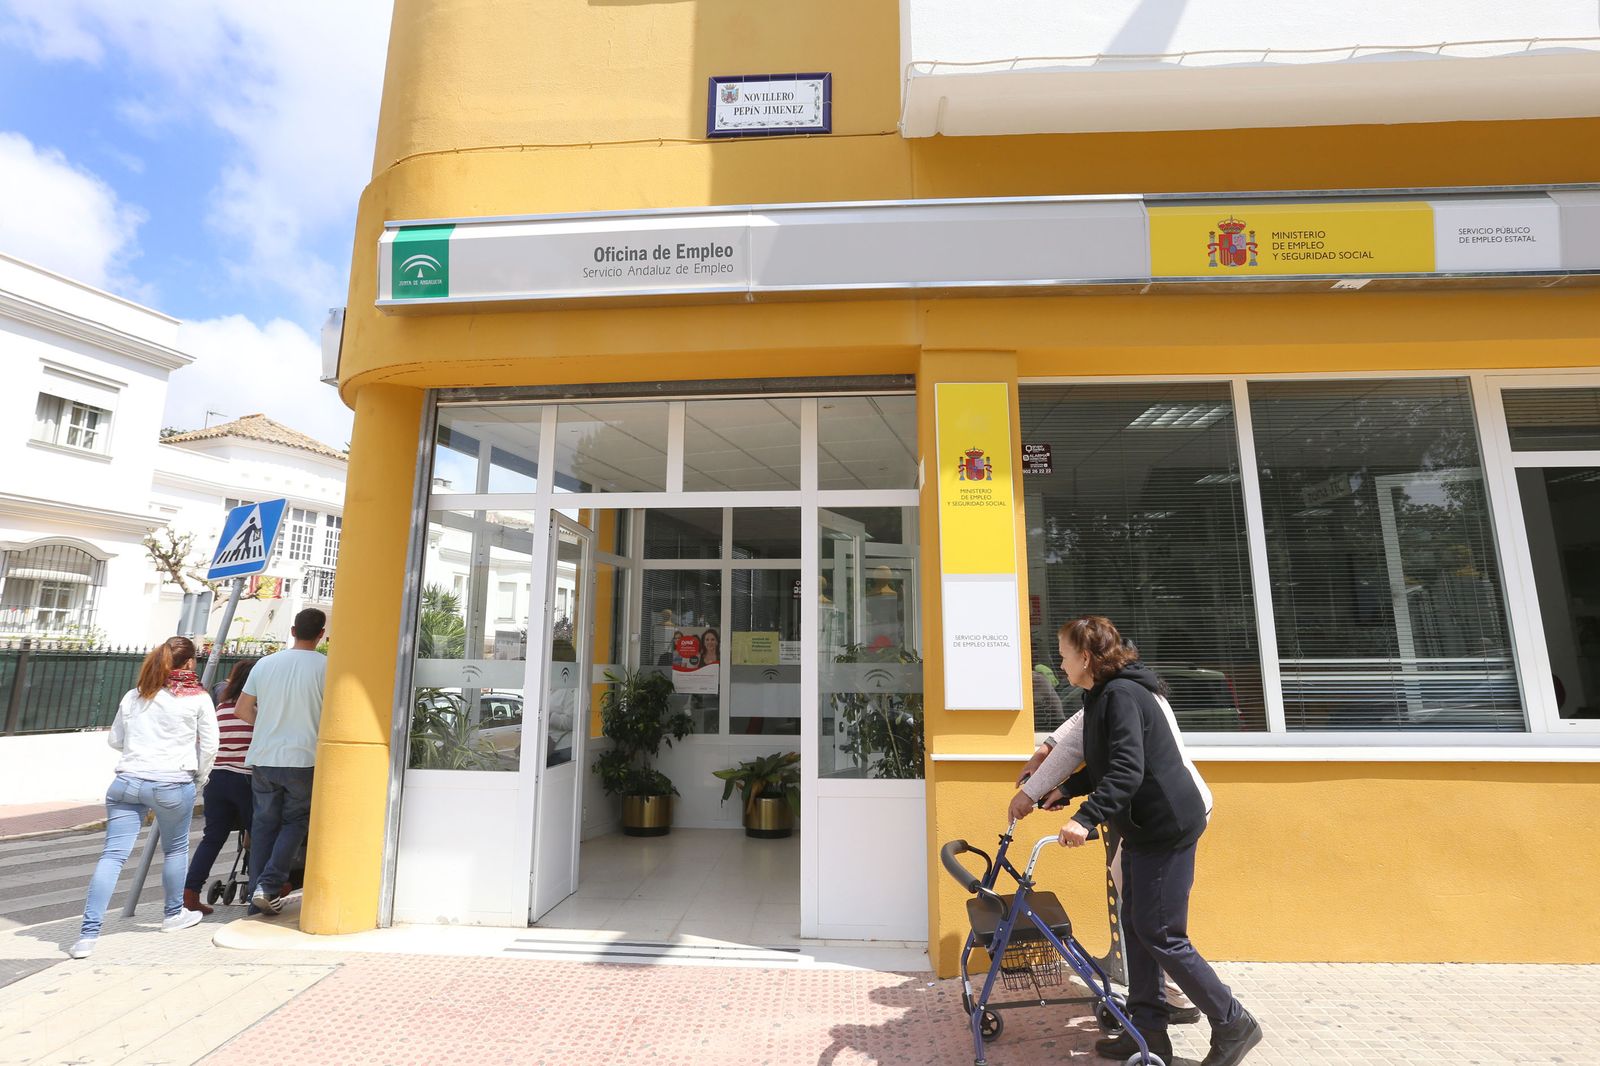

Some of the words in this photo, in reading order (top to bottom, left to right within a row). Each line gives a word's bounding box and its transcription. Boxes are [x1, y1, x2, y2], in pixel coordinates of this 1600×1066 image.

[744, 92, 794, 101] NOVILLERO
[763, 105, 804, 114] JIMENEZ
[1272, 231, 1326, 239] MINISTERIO
[1272, 242, 1285, 250] DE
[1288, 241, 1325, 249] EMPLEO
[594, 246, 648, 262] Oficina
[652, 244, 671, 260] de
[676, 242, 734, 262] Empleo
[1281, 252, 1336, 260] SEGURIDAD
[1339, 251, 1374, 259] SOCIAL
[583, 267, 622, 278] Servicio
[628, 265, 671, 276] Andaluz
[675, 264, 689, 275] de
[694, 263, 734, 275] Empleo
